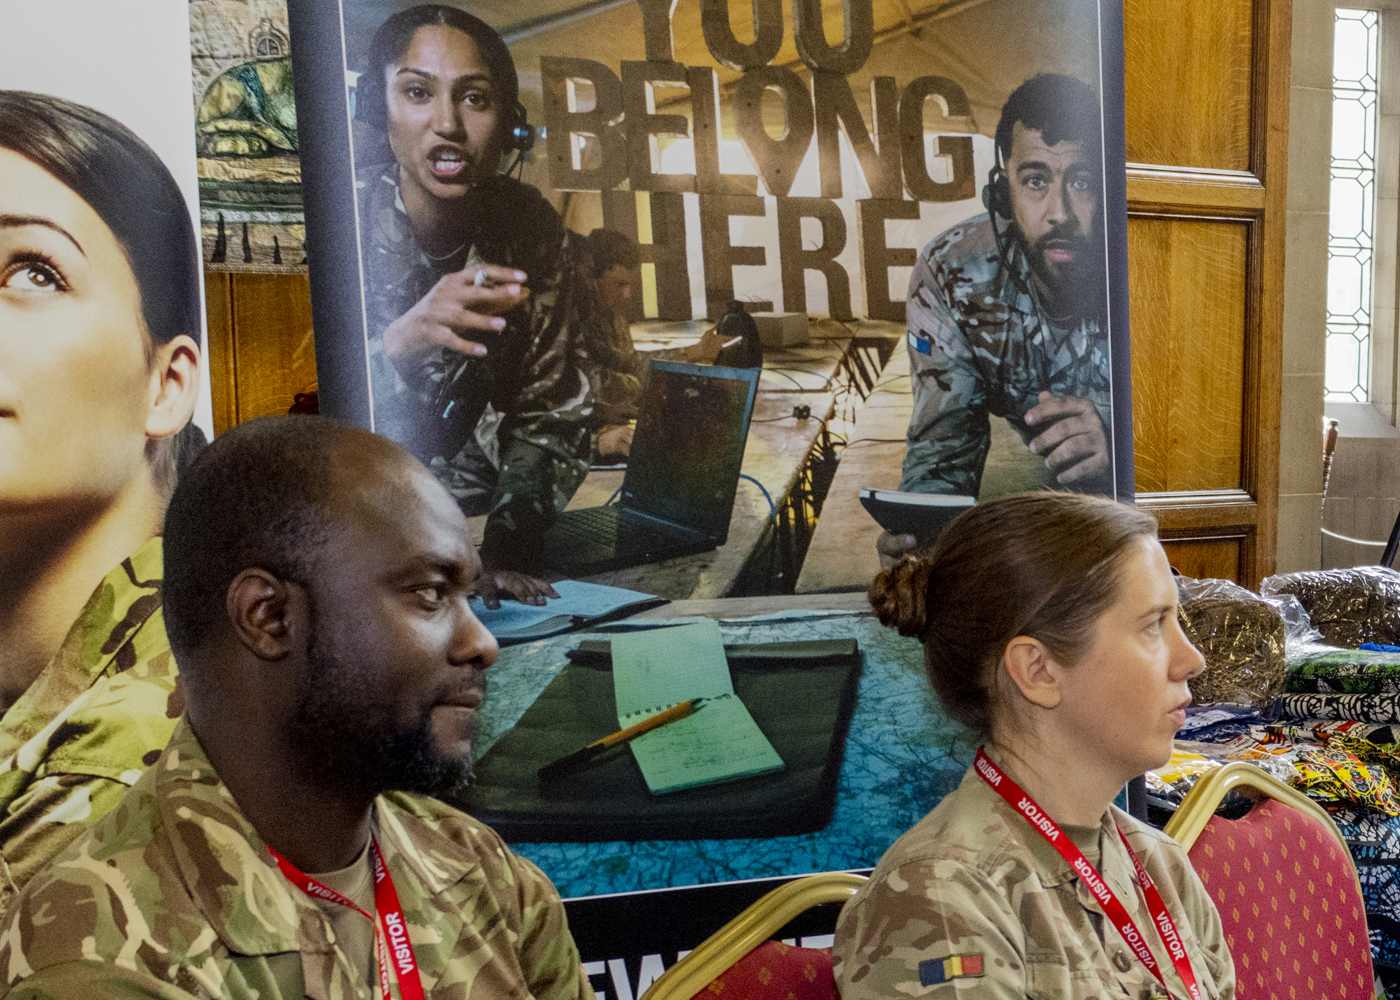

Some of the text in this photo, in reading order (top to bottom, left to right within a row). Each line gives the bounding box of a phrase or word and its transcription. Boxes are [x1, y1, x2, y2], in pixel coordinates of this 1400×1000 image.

[540, 55, 977, 203] BELONG
[602, 190, 921, 327] HERE
[976, 756, 1003, 787] VISITOR
[1017, 796, 1060, 842] VISITOR
[1074, 856, 1112, 905] VISITOR
[385, 911, 414, 975] VISITOR
[1121, 922, 1156, 970] VISITOR
[1156, 911, 1186, 961] VISITOR
